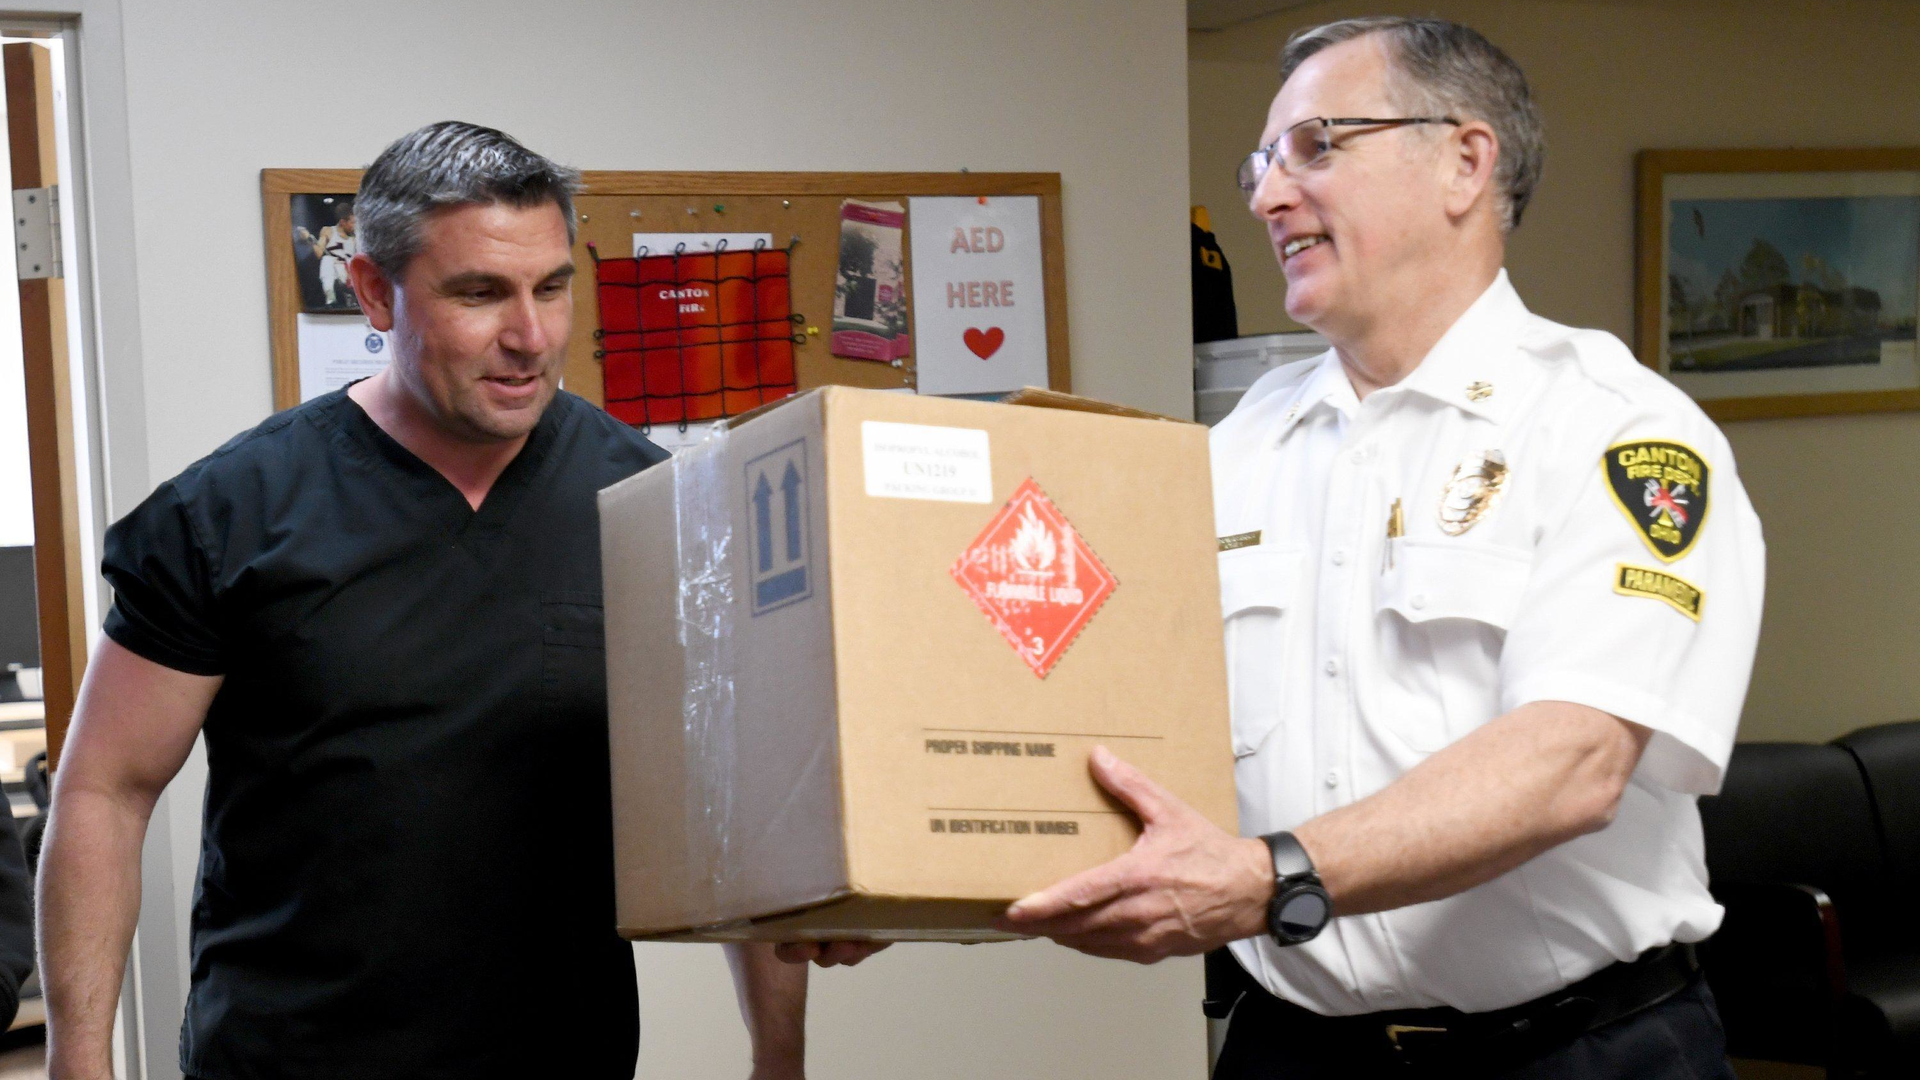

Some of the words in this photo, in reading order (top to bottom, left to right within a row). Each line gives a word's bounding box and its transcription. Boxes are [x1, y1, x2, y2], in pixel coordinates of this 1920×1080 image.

[950, 226, 1005, 253] AED
[659, 288, 710, 299] CANTON
[946, 280, 1015, 308] HERE
[902, 461, 958, 477] UN1219
[1618, 447, 1704, 480] CANTON
[1626, 464, 1662, 480] FIRE
[1031, 637, 1044, 655] 3
[925, 739, 968, 755] PROPER
[971, 741, 1022, 756] SHIPPING
[1025, 743, 1056, 757] NAME
[929, 819, 946, 833] UN
[948, 819, 1032, 835] IDENTIFICATION
[1034, 821, 1079, 835] NUMBER
